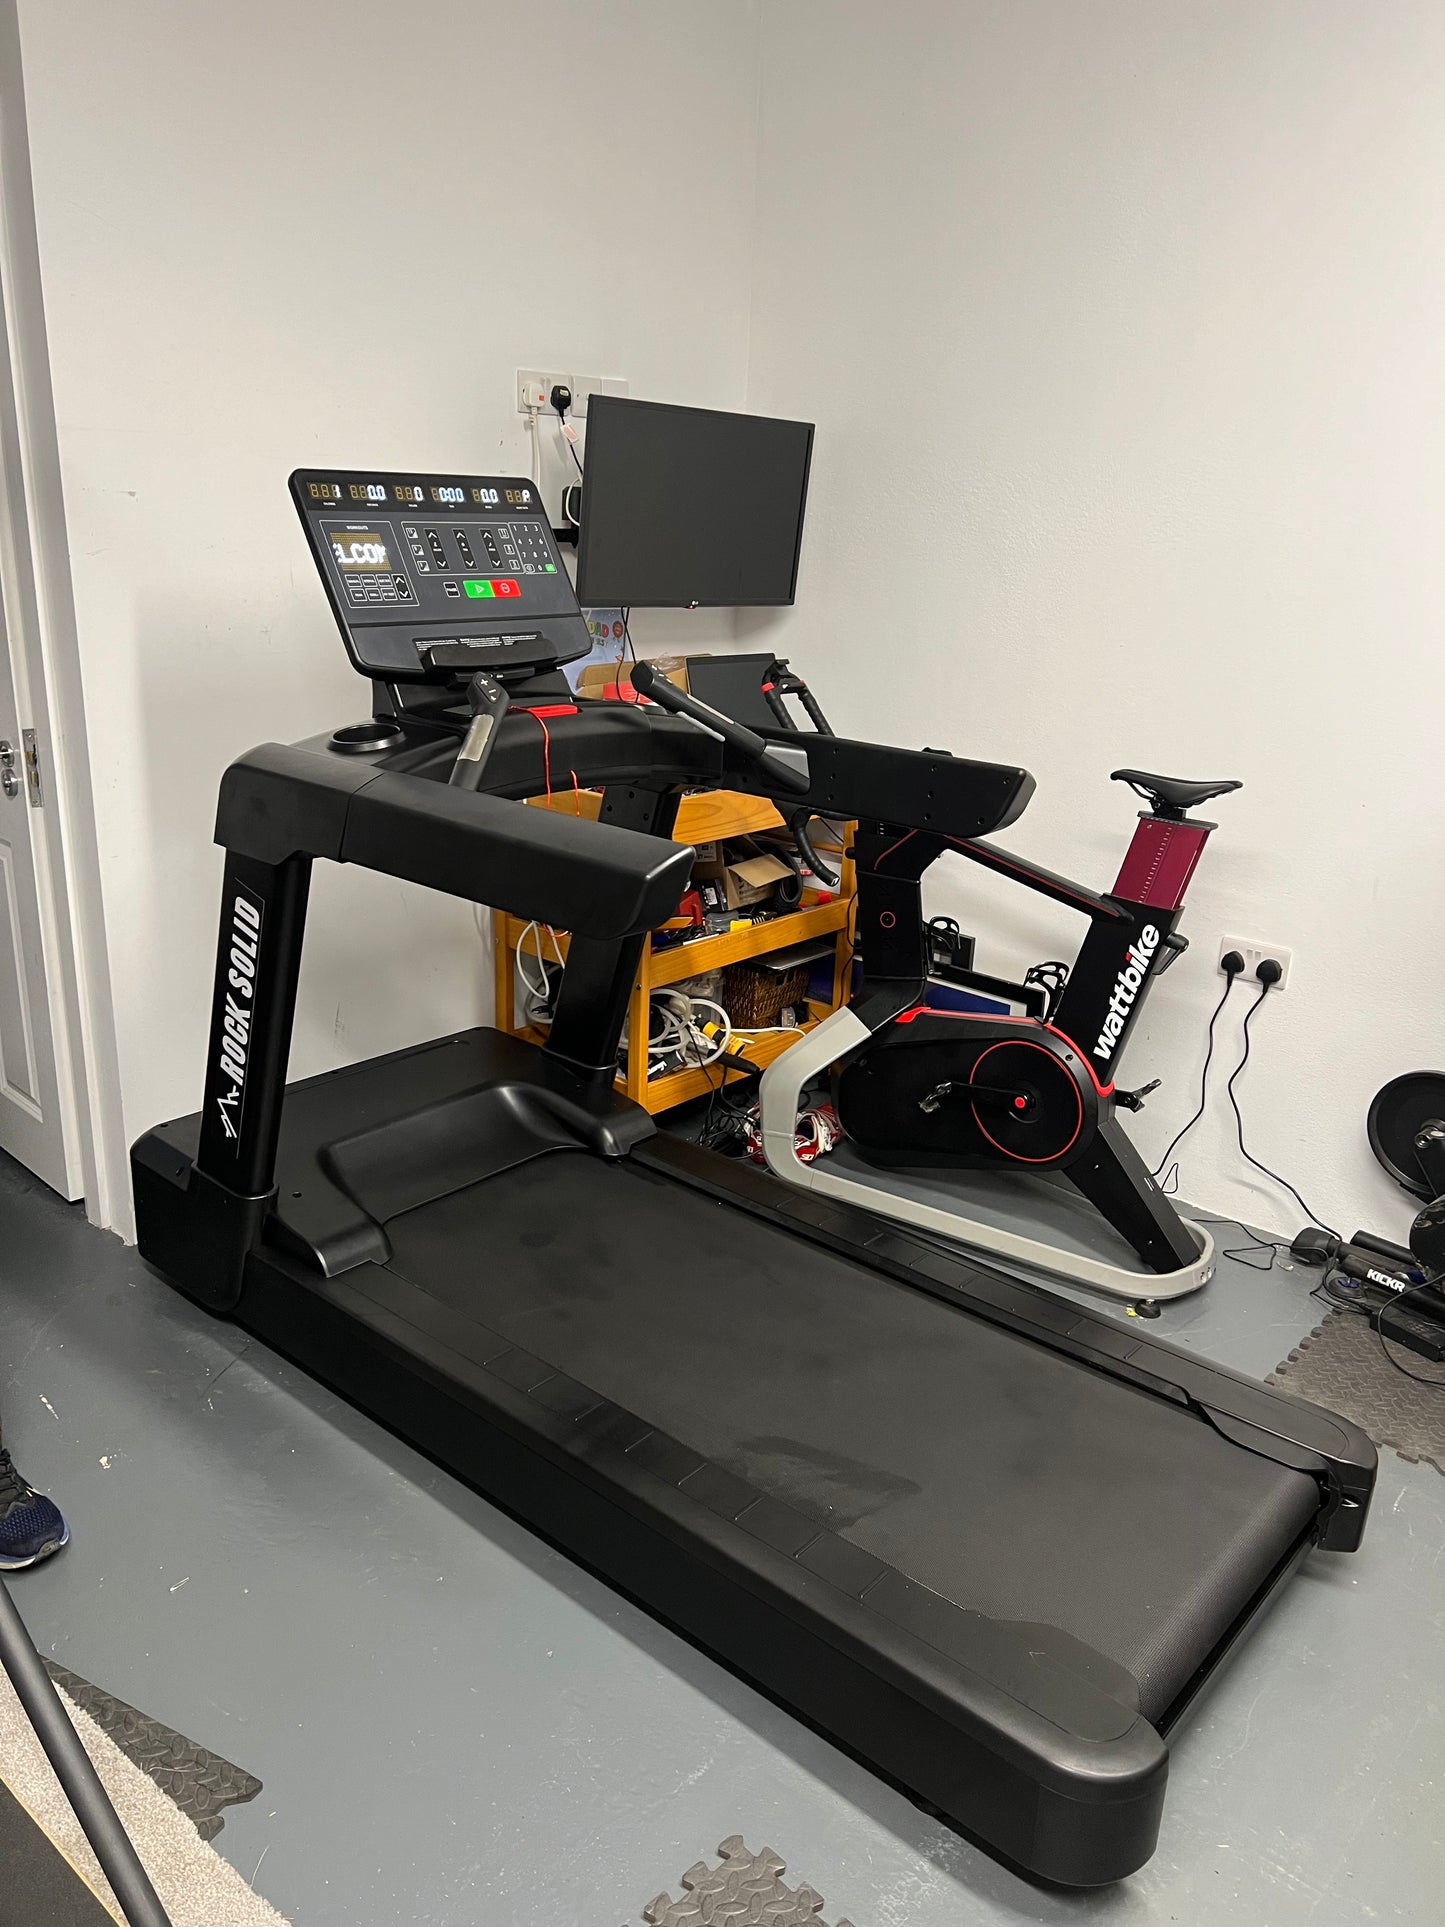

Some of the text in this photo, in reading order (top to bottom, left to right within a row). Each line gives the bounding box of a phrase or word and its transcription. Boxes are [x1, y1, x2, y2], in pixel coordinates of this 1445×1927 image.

[220, 896, 260, 1086] ROCK SOLID
[1093, 924, 1160, 1060] wattbike
[1366, 1268, 1406, 1293] KICKR
